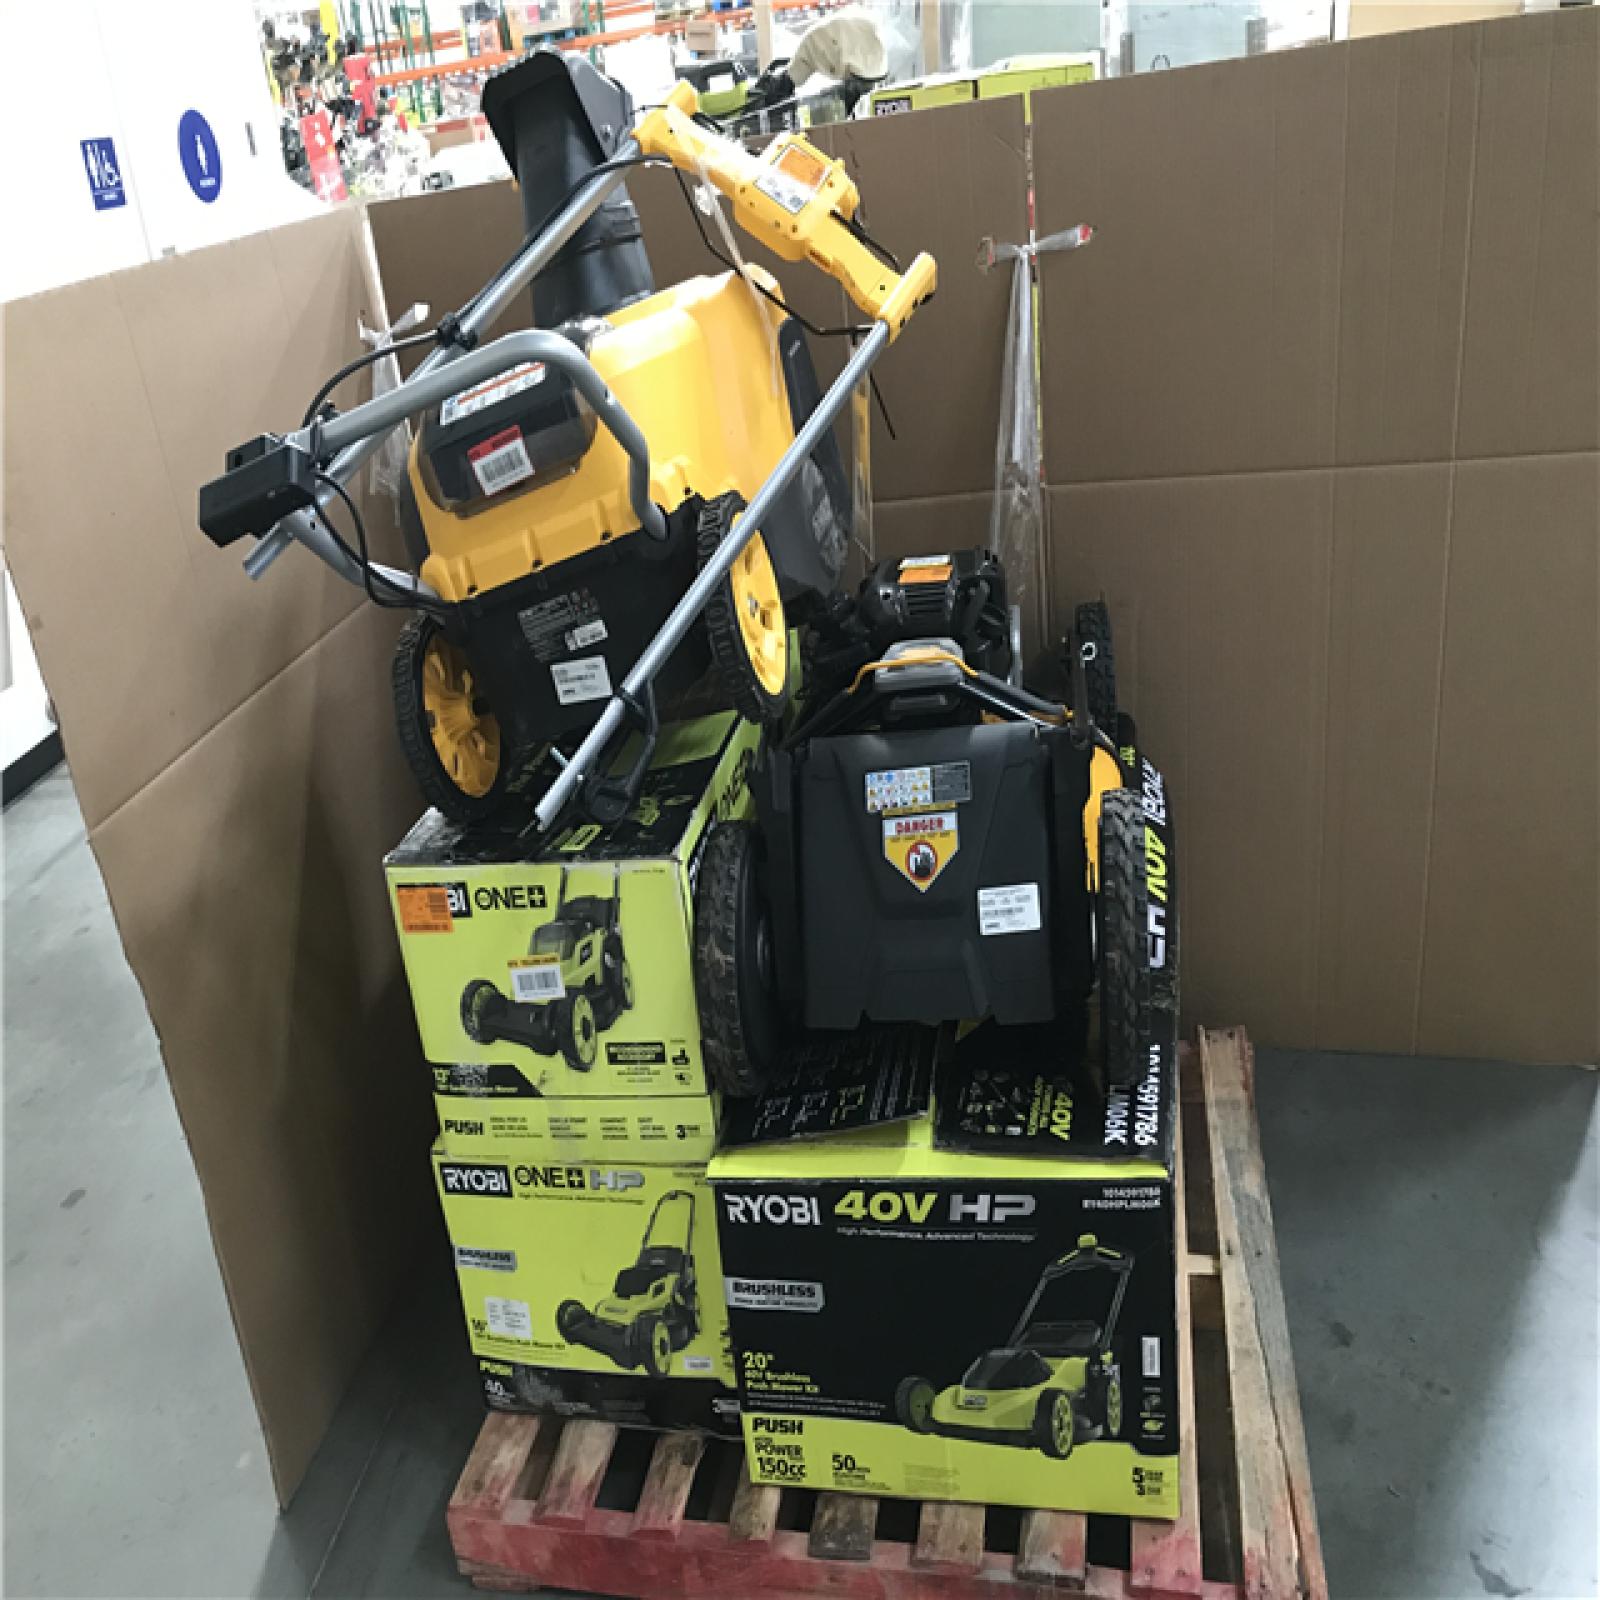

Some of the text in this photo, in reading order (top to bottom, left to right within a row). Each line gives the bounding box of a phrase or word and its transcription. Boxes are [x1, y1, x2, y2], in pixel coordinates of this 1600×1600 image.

[896, 817, 944, 834] DANGER
[1050, 1092, 1073, 1141] 40V
[444, 1119, 484, 1136] PUSH
[443, 1168, 509, 1193] RYOBI
[590, 1168, 644, 1192] HP
[724, 1191, 1036, 1225] RYOBI 40V HP
[734, 1281, 816, 1298] BRUSHLESS
[752, 1417, 803, 1435] PUSH
[832, 1454, 856, 1471] 50
